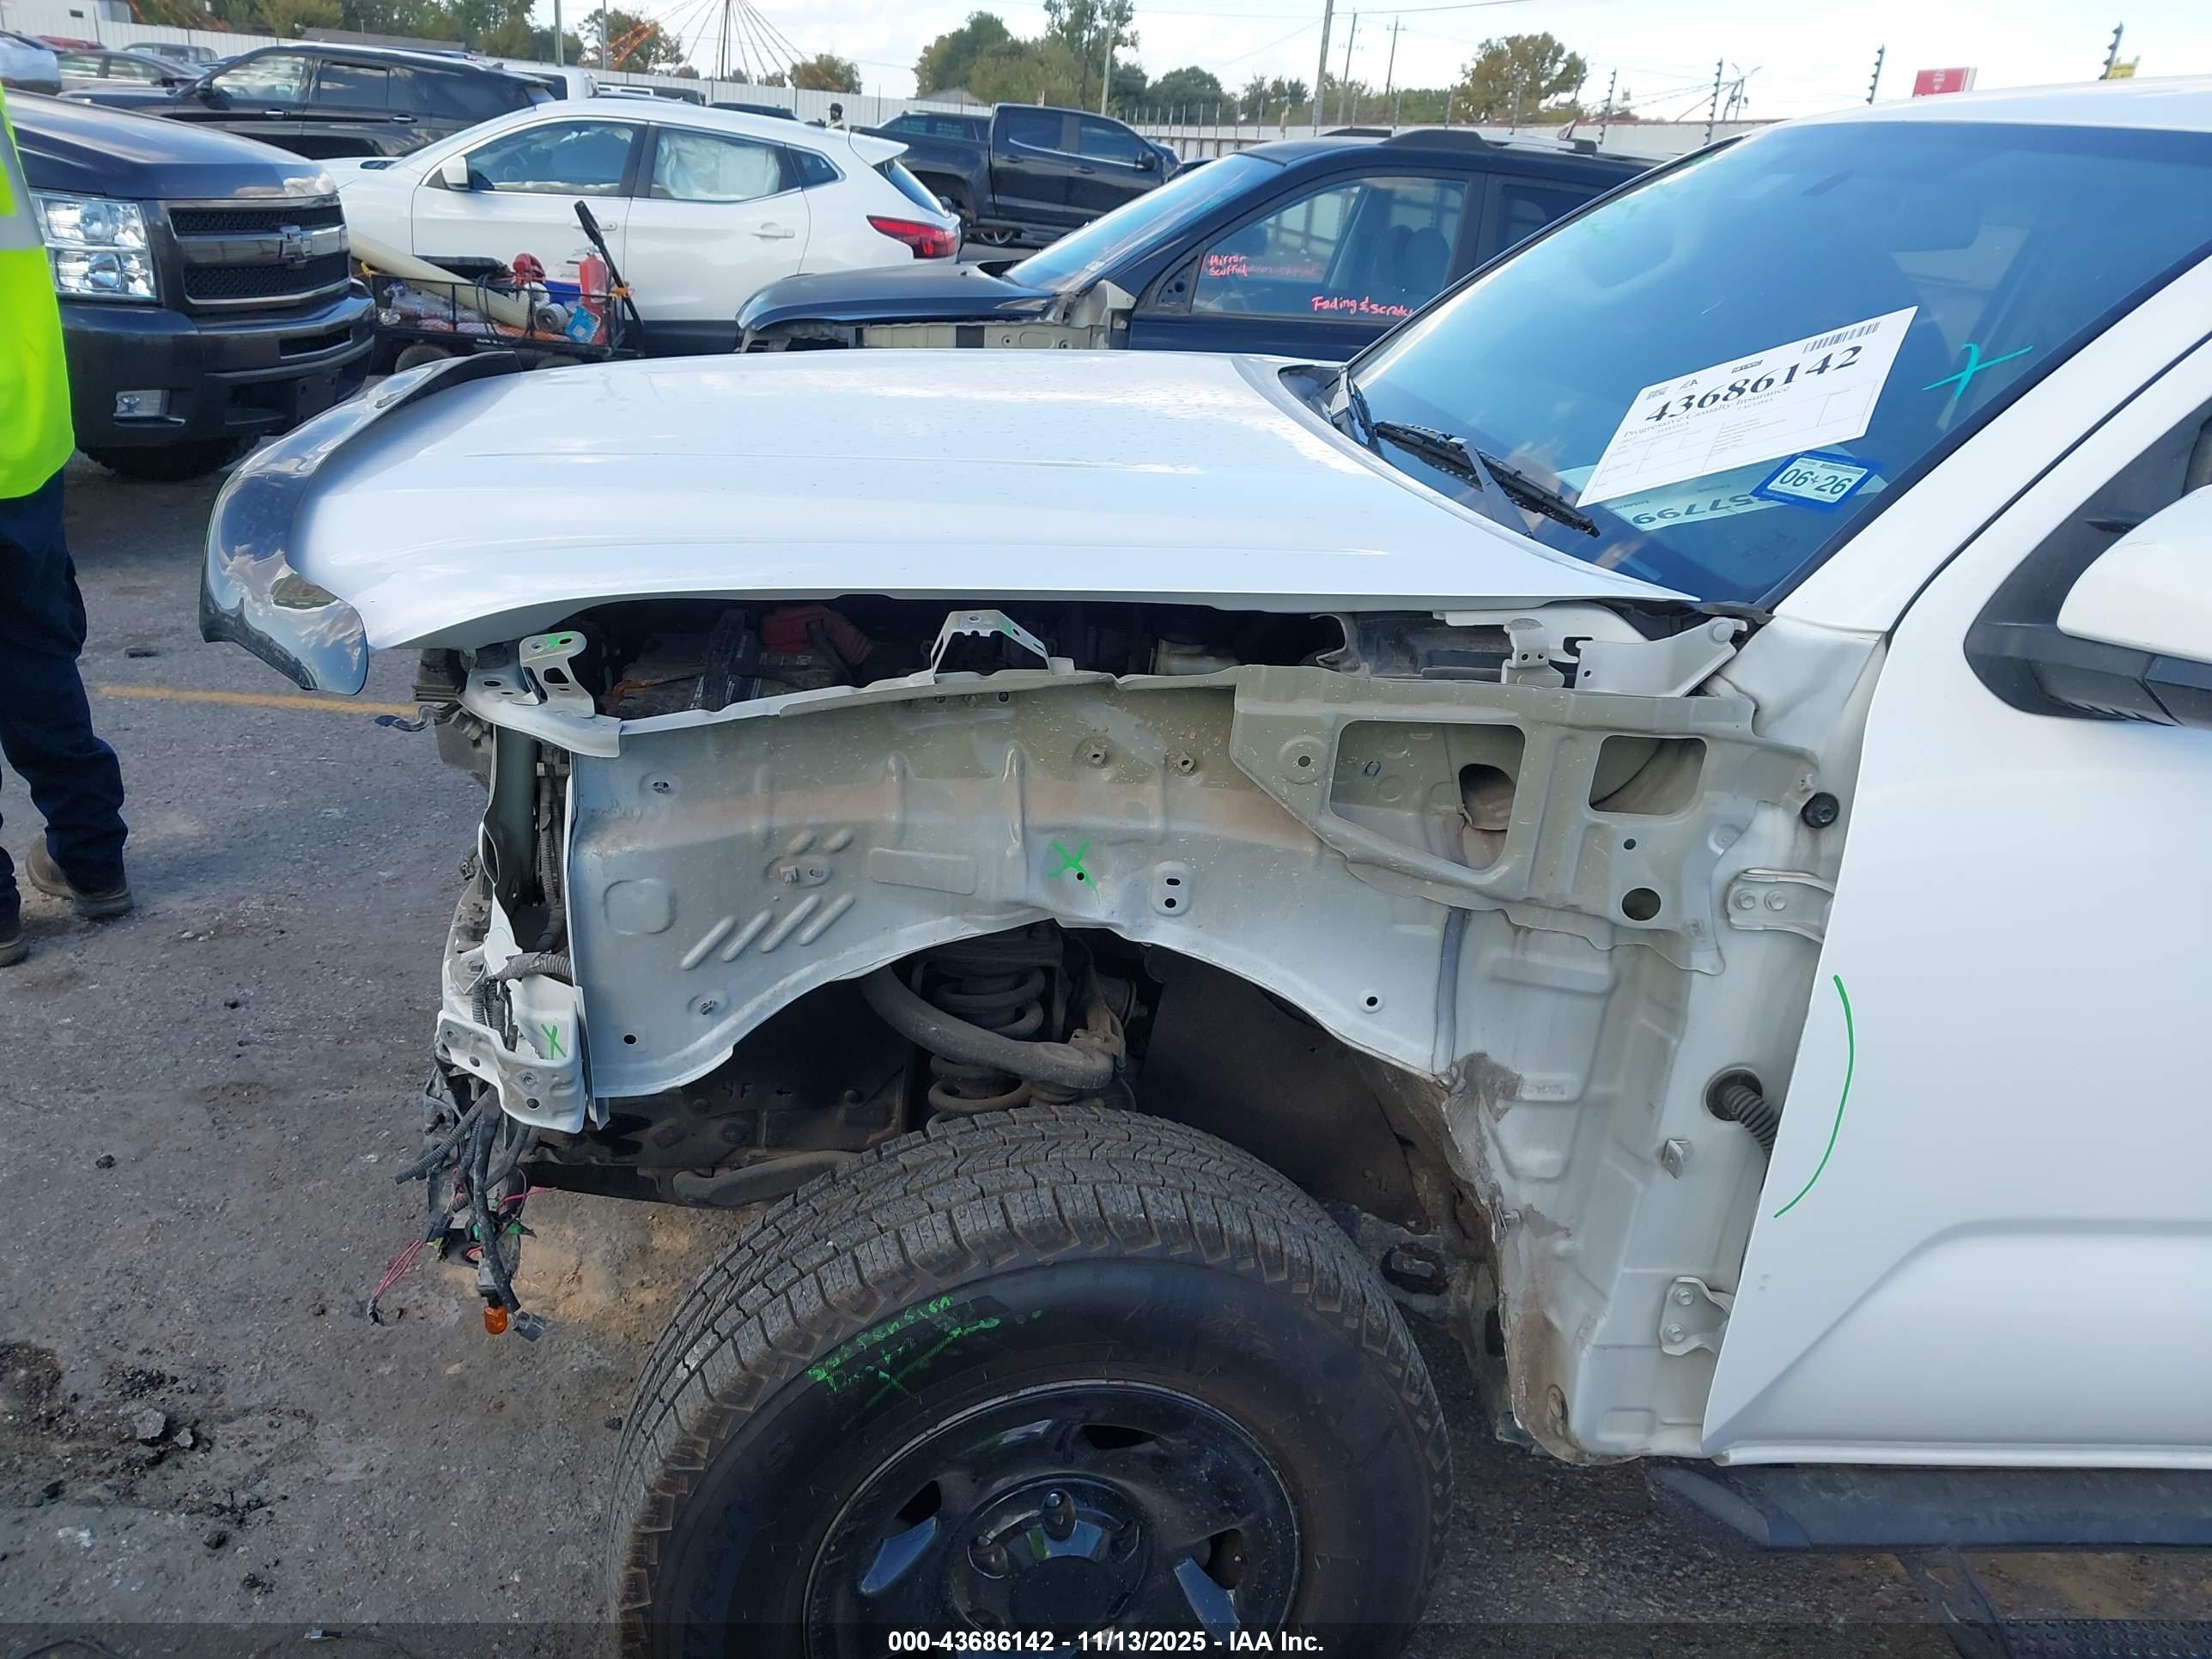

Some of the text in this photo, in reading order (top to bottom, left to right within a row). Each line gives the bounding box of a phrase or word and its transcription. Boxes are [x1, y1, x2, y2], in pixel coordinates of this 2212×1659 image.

[1209, 254, 1248, 266] Mirror
[1312, 295, 1357, 315] Fading
[1644, 345, 1863, 422] 43686142
[1779, 467, 1814, 488] 06
[1814, 474, 1853, 495] 26
